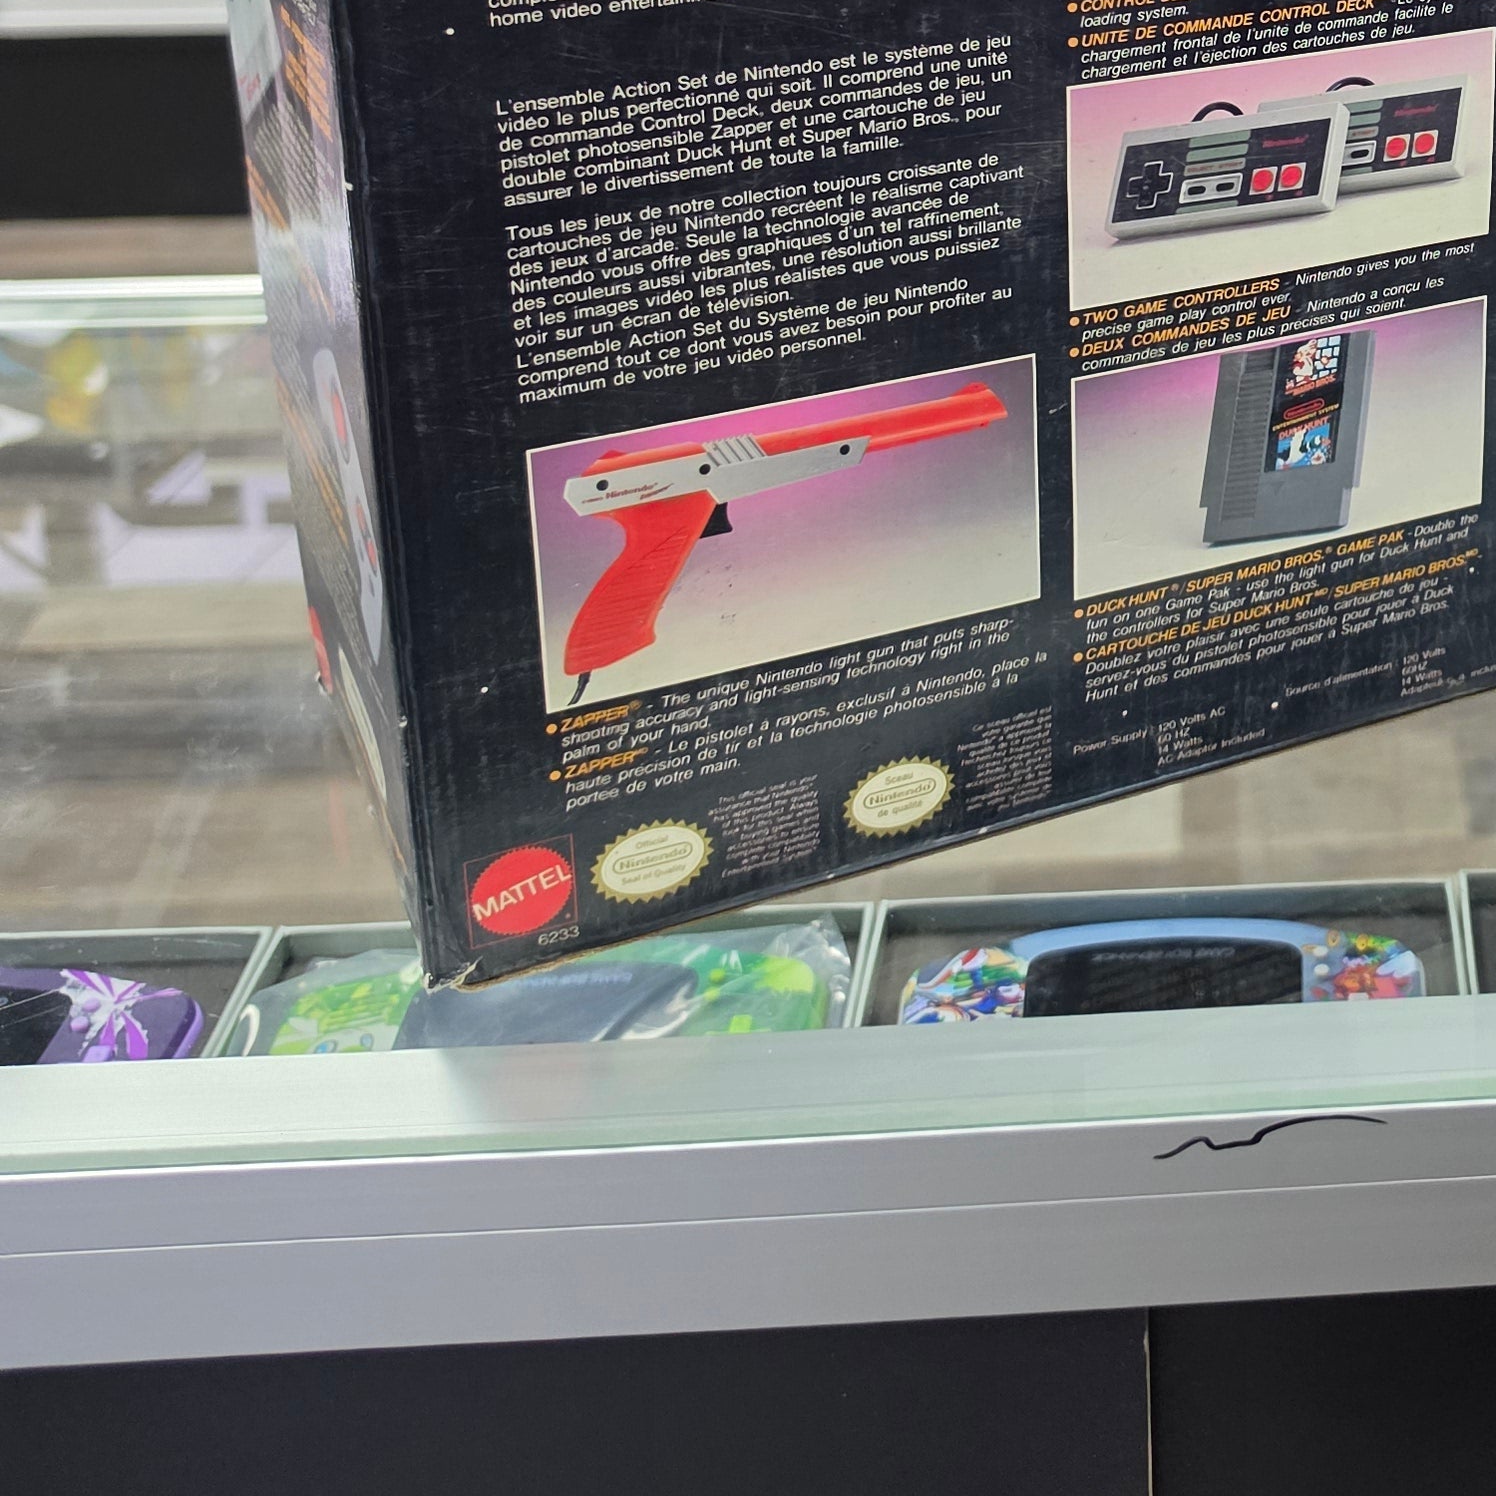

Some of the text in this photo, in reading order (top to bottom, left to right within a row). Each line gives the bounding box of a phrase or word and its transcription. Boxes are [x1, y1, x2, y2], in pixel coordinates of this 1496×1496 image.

[1079, 5, 1189, 28] loading system.
[1081, 28, 1130, 47] UNITE
[1134, 25, 1158, 40] DE
[1163, 12, 1254, 36] COMMANDE
[1259, 2, 1330, 23] CONTROL
[496, 35, 1011, 115] L'ensemble Action Set de Nintendo est le système de jeu
[1082, 242, 1474, 325] TWO GAME CONTROLLERS Nintendo gives you the most
[1081, 336, 1125, 356] DEUX
[1131, 317, 1230, 347] COMMANDES
[1235, 311, 1257, 327] DE
[1261, 305, 1291, 322] JEU
[1306, 291, 1366, 313] Nintendo
[1369, 289, 1378, 300] a
[1425, 277, 1444, 288] les
[1081, 322, 1132, 343] precise
[1136, 314, 1174, 333] game
[1178, 308, 1207, 324] play
[1211, 296, 1257, 316] control
[1085, 596, 1127, 617] DUCK
[1127, 585, 1169, 607] HUNT
[1185, 570, 1233, 592] SUPER
[1235, 559, 1281, 580] MARIO
[1336, 536, 1376, 556] GAME
[1377, 529, 1404, 546] PAK
[1158, 706, 1226, 733] 120 Volts AC
[1073, 727, 1148, 756] Power Supply
[869, 782, 932, 805] Nintendo
[885, 772, 914, 785] Sceau
[618, 845, 687, 871] Nintendo
[472, 864, 572, 921] MATTEL
[537, 925, 580, 946] 6233
